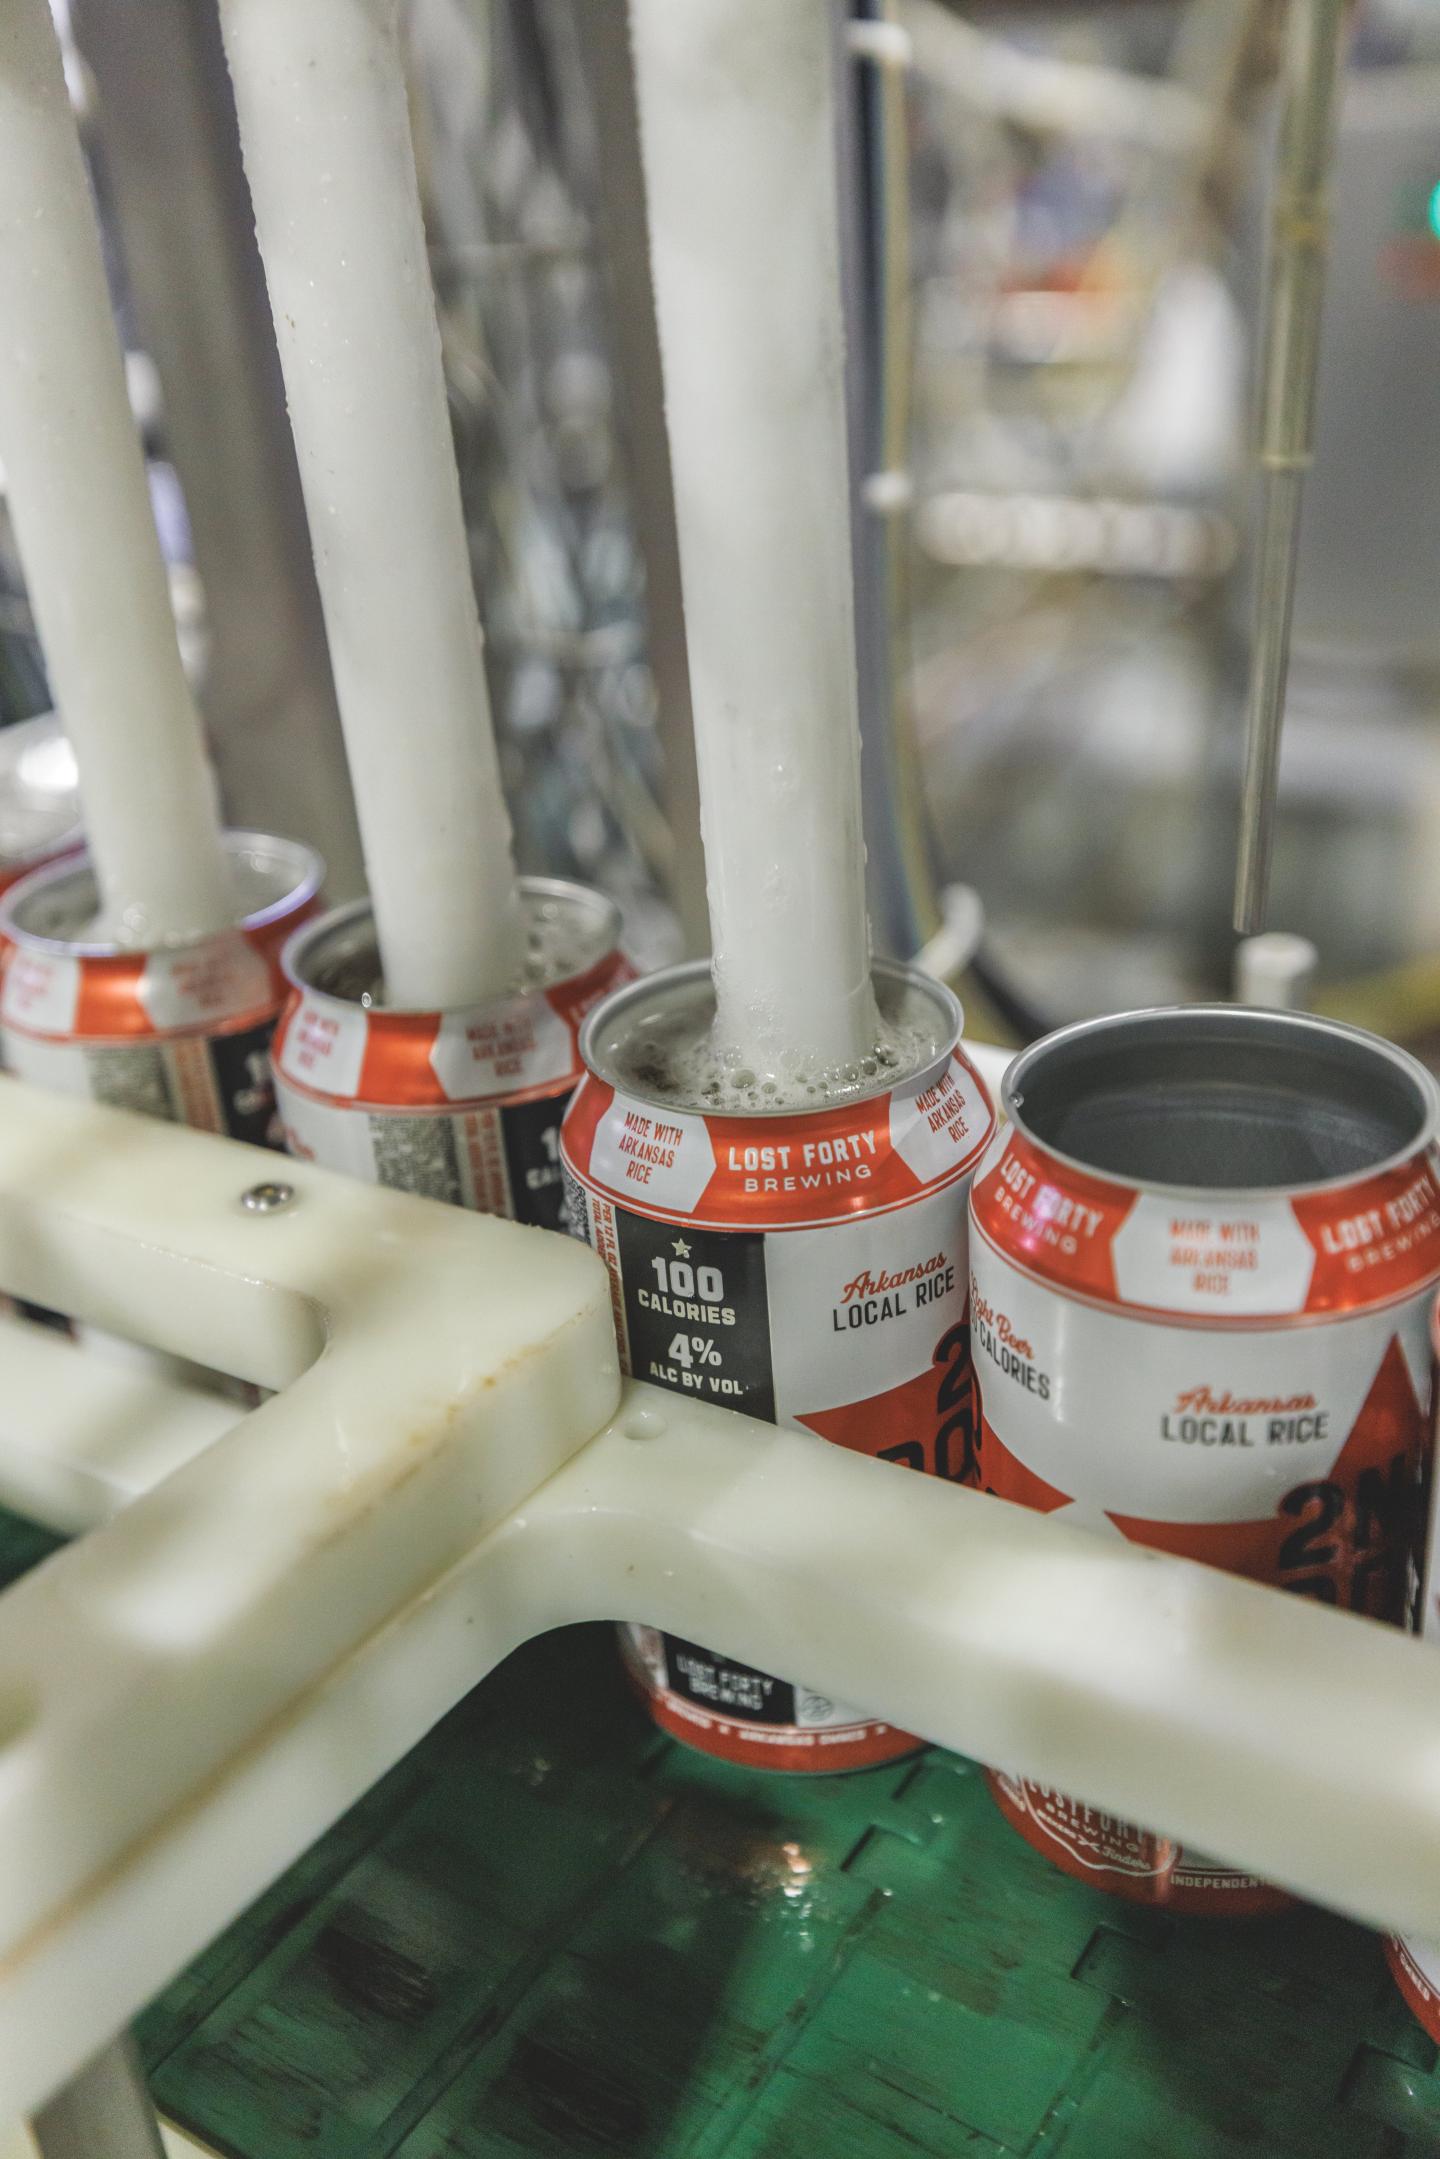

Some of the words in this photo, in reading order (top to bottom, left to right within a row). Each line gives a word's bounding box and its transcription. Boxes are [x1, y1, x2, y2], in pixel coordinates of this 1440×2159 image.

[915, 1086, 941, 1114] MADE
[928, 1089, 966, 1134] ARKANSAS
[624, 1111, 652, 1138] MADE
[654, 1122, 683, 1147] WITH
[948, 1116, 969, 1143] RICE
[619, 1133, 675, 1169] ARKANSAS
[728, 1146, 791, 1171] LOST
[803, 1129, 876, 1168] FORTY
[626, 1160, 653, 1184] RICE
[744, 1164, 872, 1192] BREWING
[1001, 1152, 1036, 1201] LOST
[995, 1186, 1078, 1255] BREWING
[1321, 1210, 1384, 1254] LOST
[1385, 1175, 1436, 1230] FORTY
[651, 1256, 724, 1302] 100
[841, 1252, 947, 1304] Arkansas
[638, 1289, 736, 1326] CALORIES
[833, 1293, 907, 1331] LOCAL
[916, 1266, 954, 1308] RICE
[668, 1333, 722, 1368] 4%
[980, 1320, 1050, 1400] CALORIES
[650, 1362, 678, 1383] ALC
[682, 1371, 703, 1389] BY
[709, 1376, 743, 1395] VOL
[1175, 1385, 1318, 1414] Arkansas
[1161, 1413, 1254, 1447] LOCAL
[1268, 1410, 1330, 1445] RICE
[1046, 1802, 1139, 1852] BREWING
